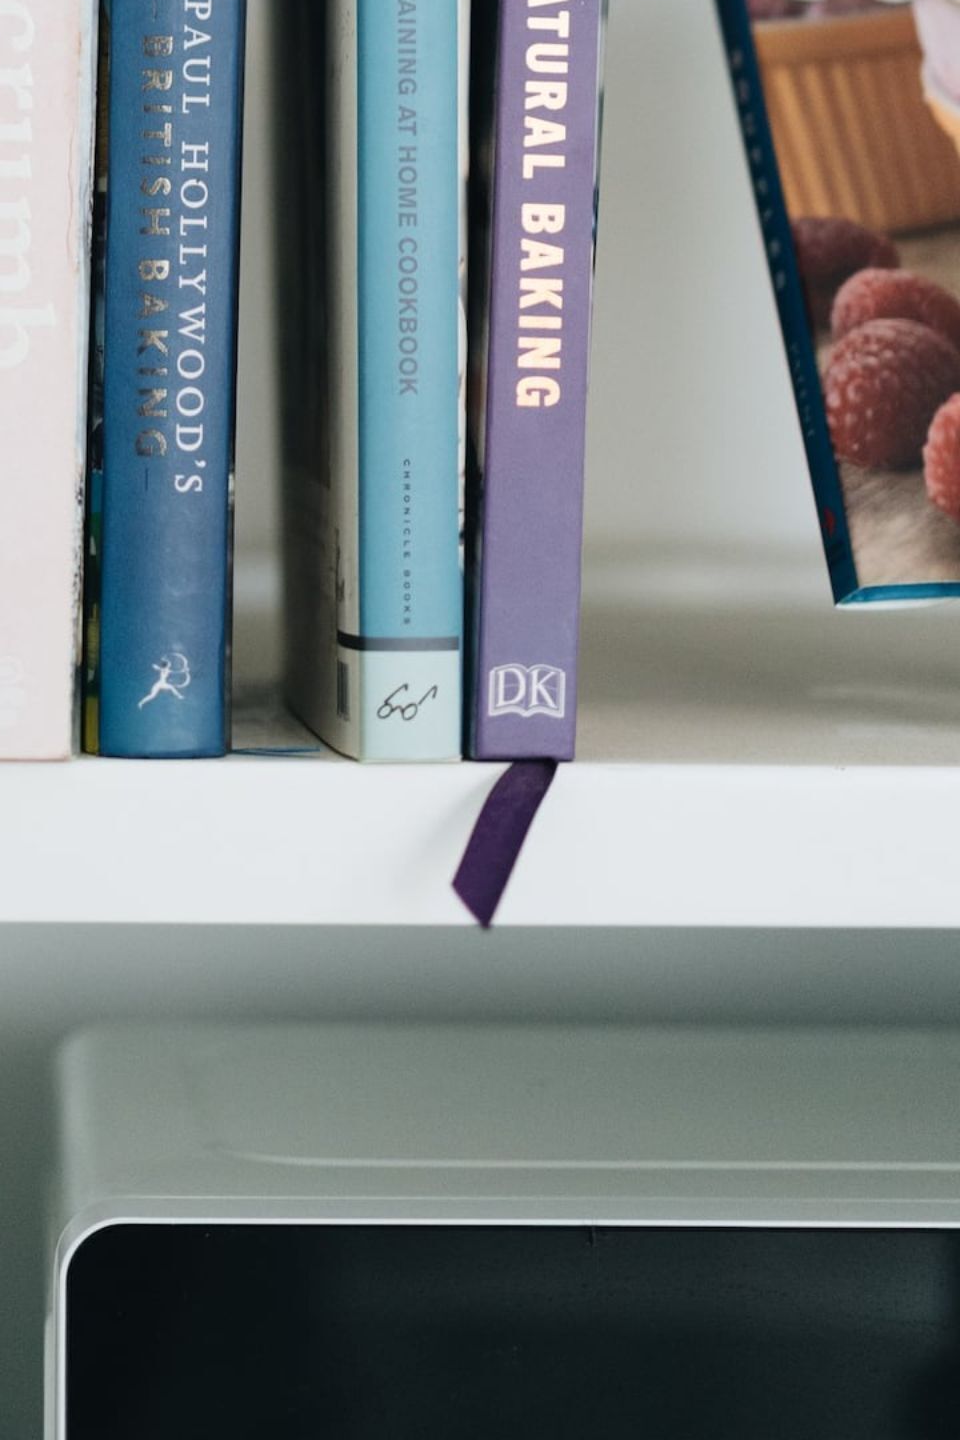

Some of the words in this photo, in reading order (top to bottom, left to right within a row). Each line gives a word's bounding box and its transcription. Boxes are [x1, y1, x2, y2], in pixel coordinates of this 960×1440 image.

[141, 35, 174, 236] BRITISH
[397, 106, 417, 136] AT
[397, 145, 418, 228] HOME
[135, 259, 170, 457] BAKING
[174, 141, 209, 493] HOLLYWOOD'S
[397, 237, 419, 396] COOKBOOK
[515, 203, 566, 408] BAKING
[402, 457, 412, 559] CHRONICLE
[402, 568, 412, 626] BOOKS
[495, 667, 559, 709] DK
